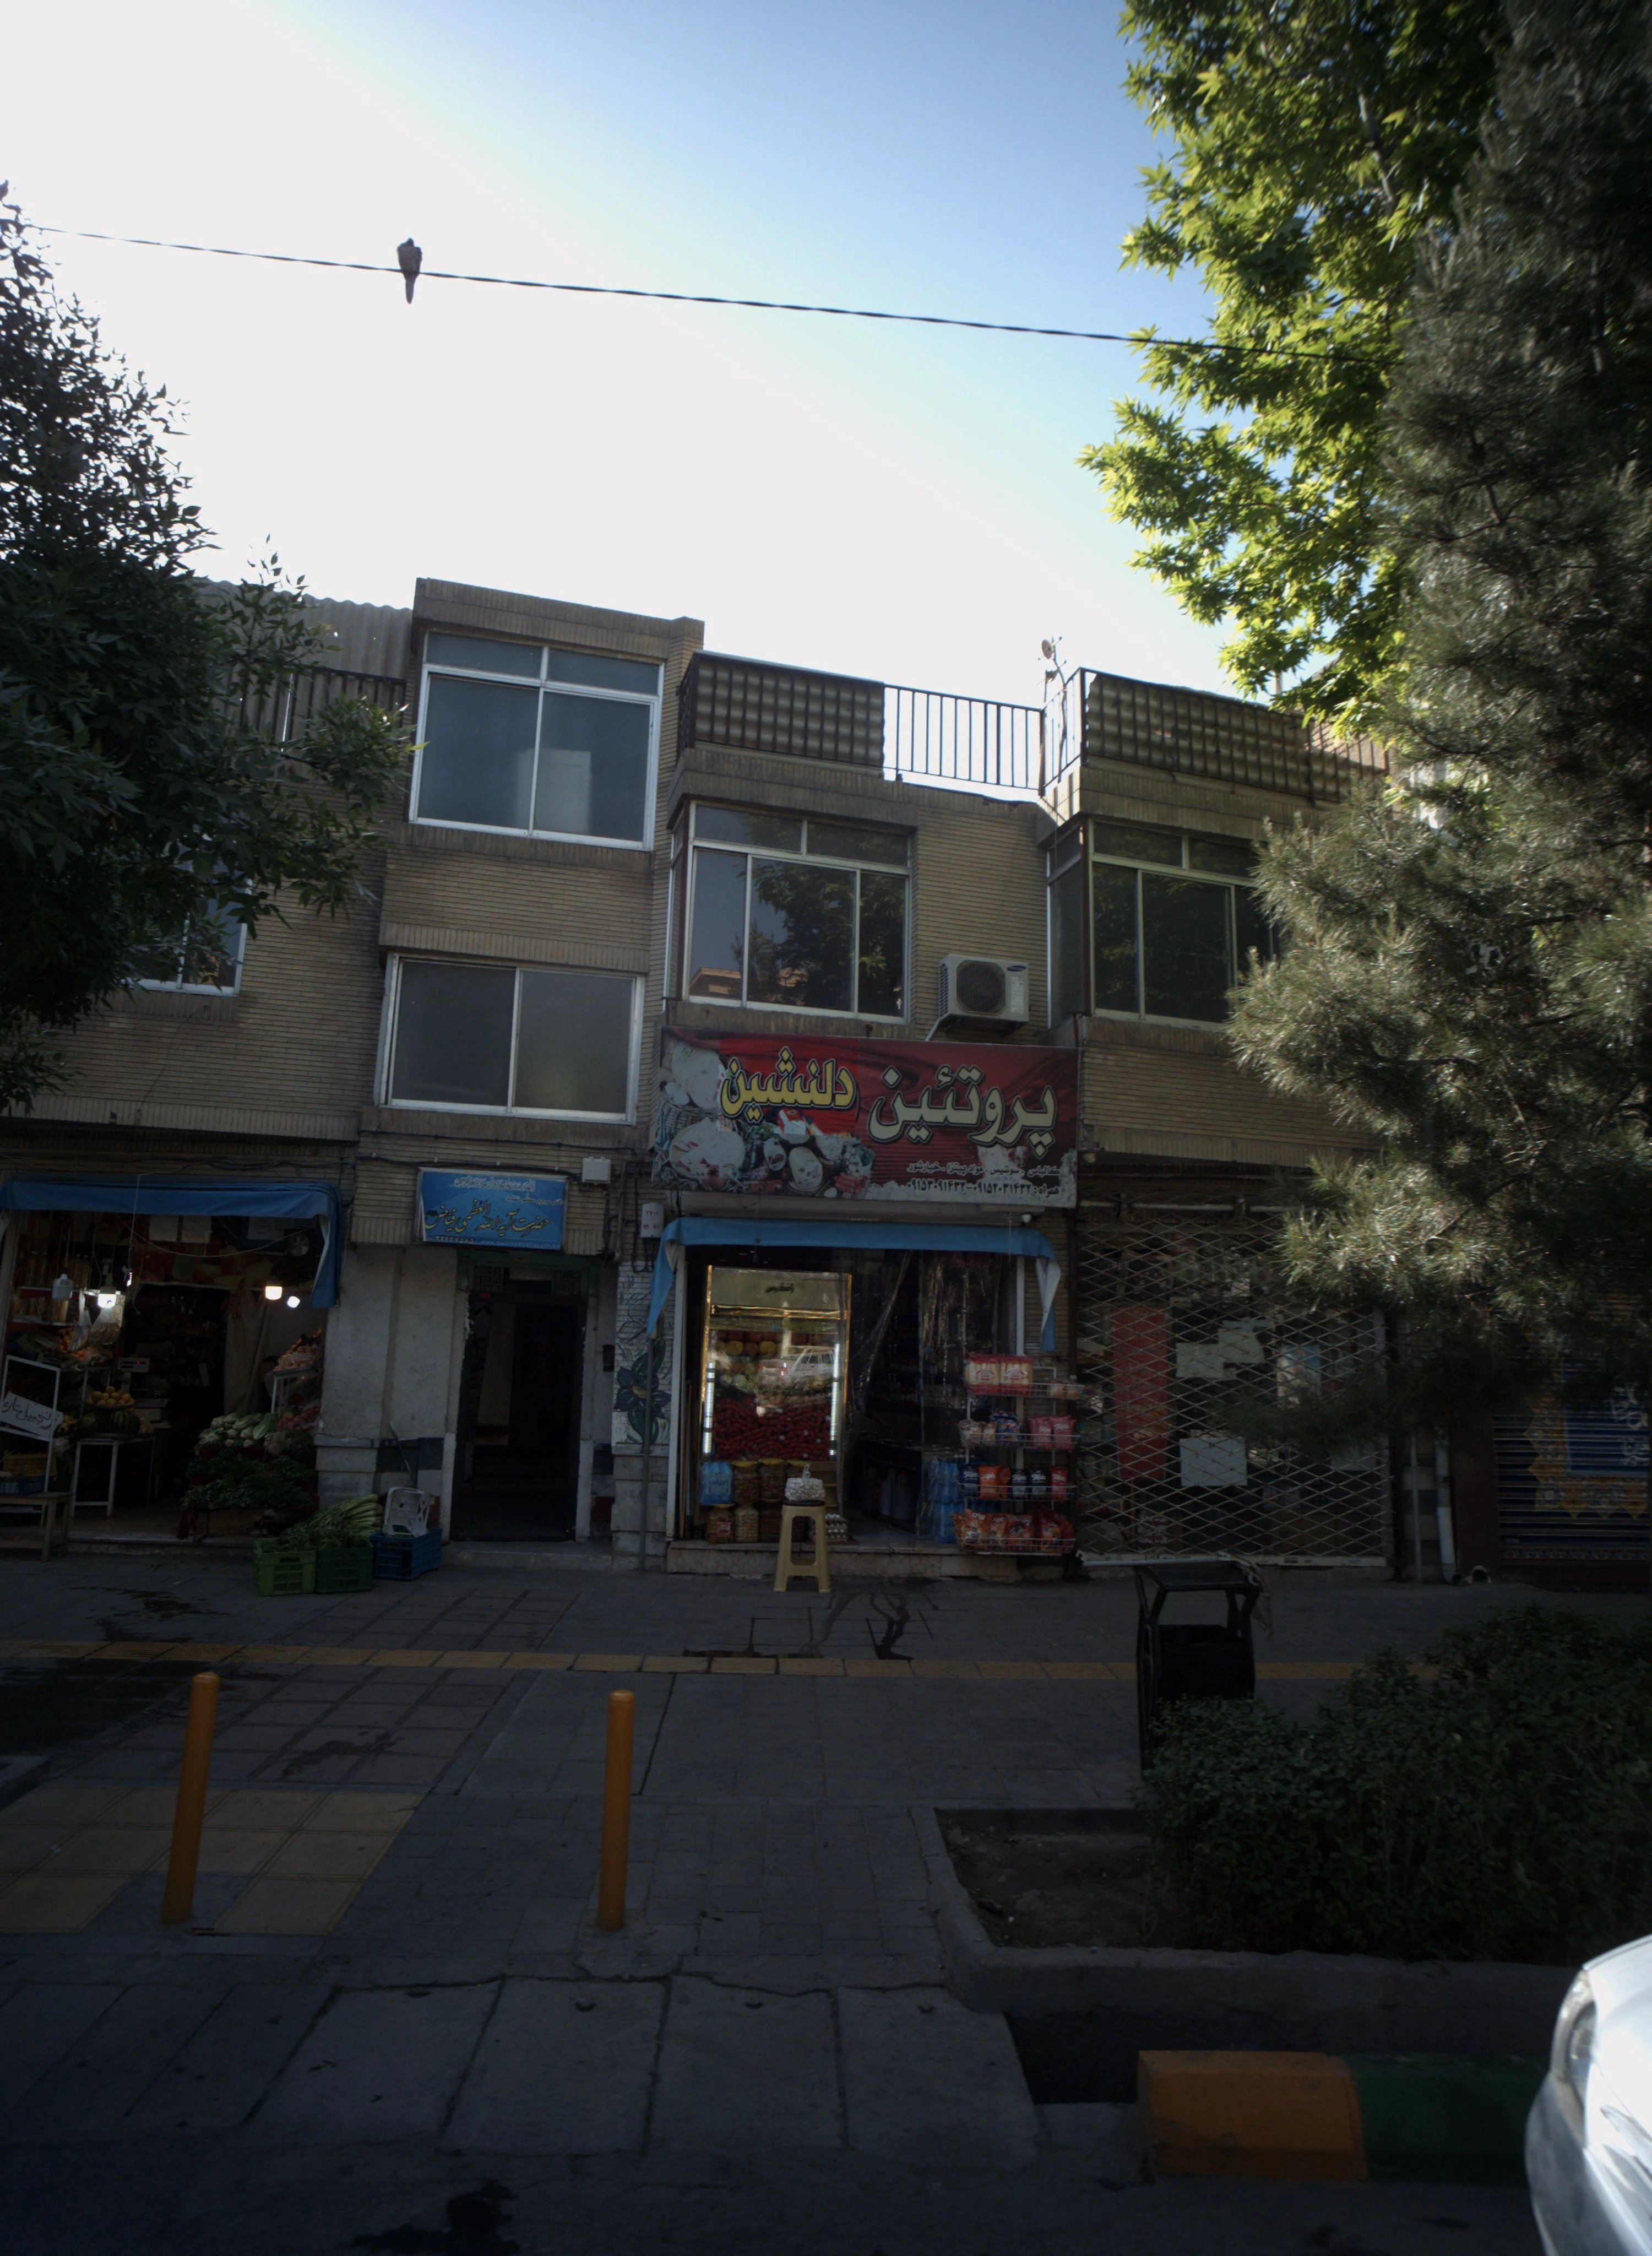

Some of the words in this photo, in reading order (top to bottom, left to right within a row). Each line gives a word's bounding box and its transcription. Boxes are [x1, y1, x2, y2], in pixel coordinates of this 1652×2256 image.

[720, 1046, 857, 1124] دلنشین
[867, 1064, 1057, 1160] پروتئین
[907, 1160, 940, 1173] خیارشور
[968, 1164, 984, 1174] مواد
[990, 1166, 1020, 1175] سوسیس
[1028, 1165, 1059, 1177] کالباس
